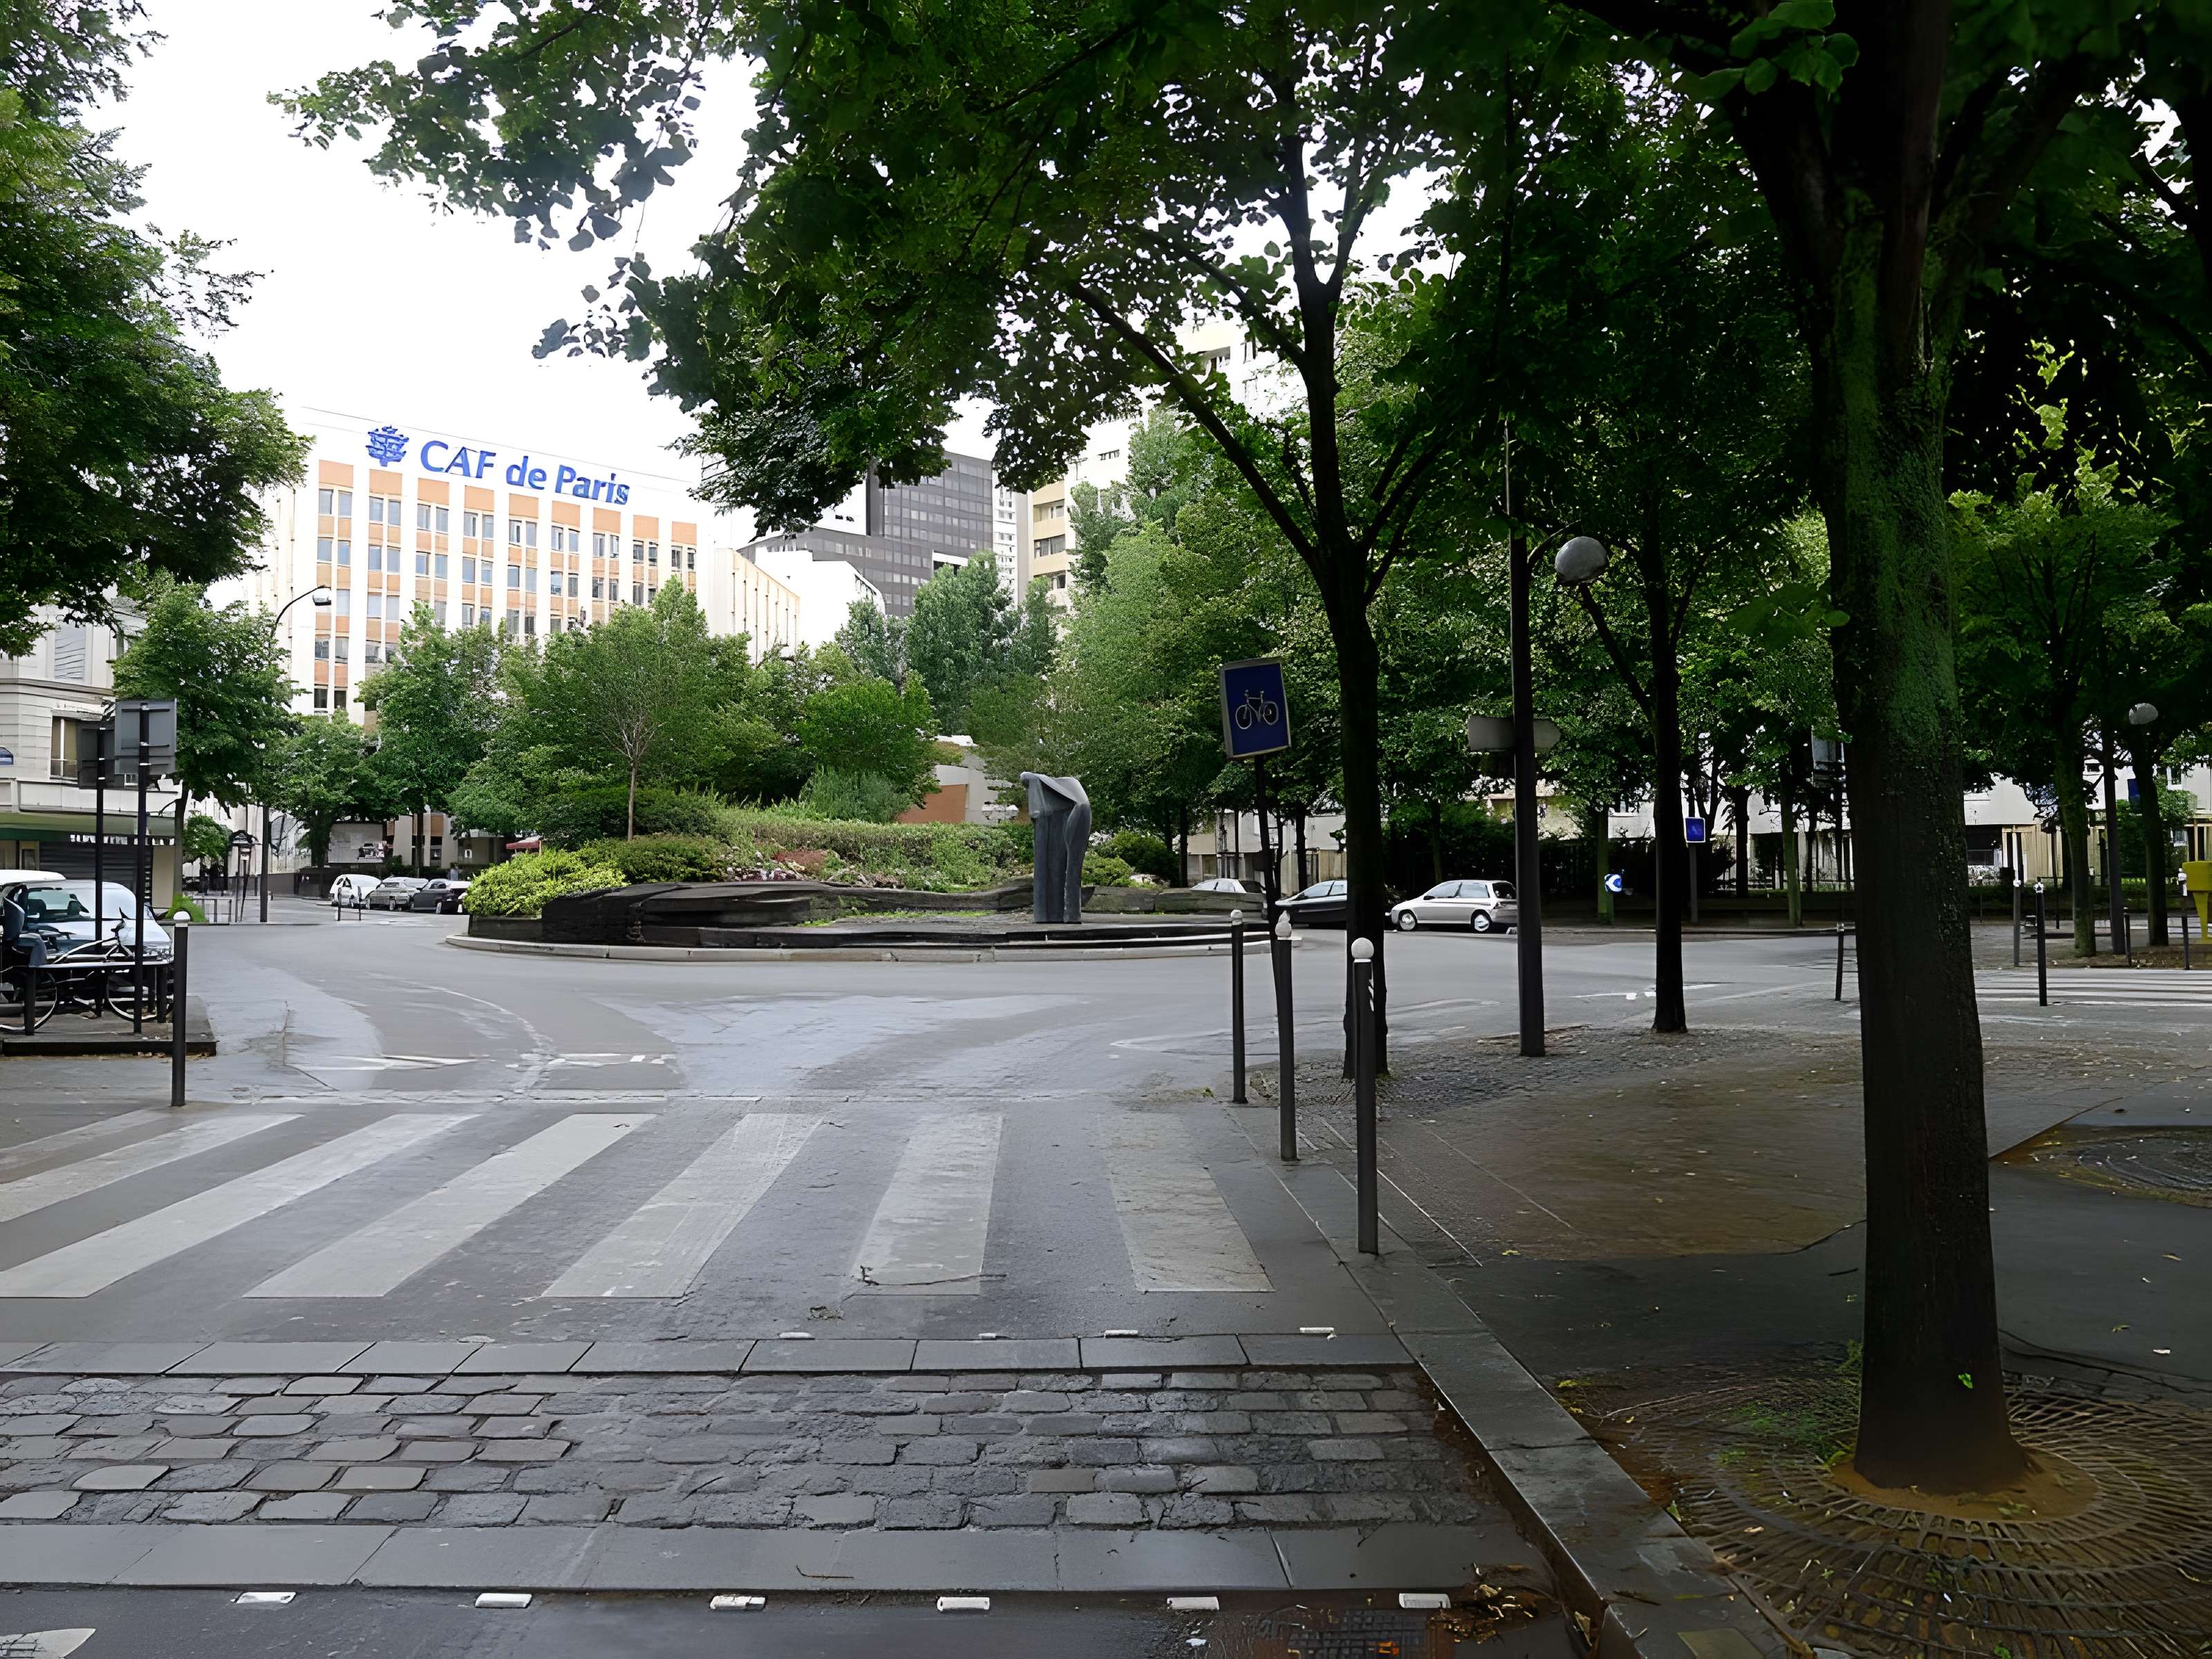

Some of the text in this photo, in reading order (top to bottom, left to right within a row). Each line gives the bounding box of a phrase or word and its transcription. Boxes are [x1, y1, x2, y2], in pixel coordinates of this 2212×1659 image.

[420, 440, 630, 505] CAF de Paris
